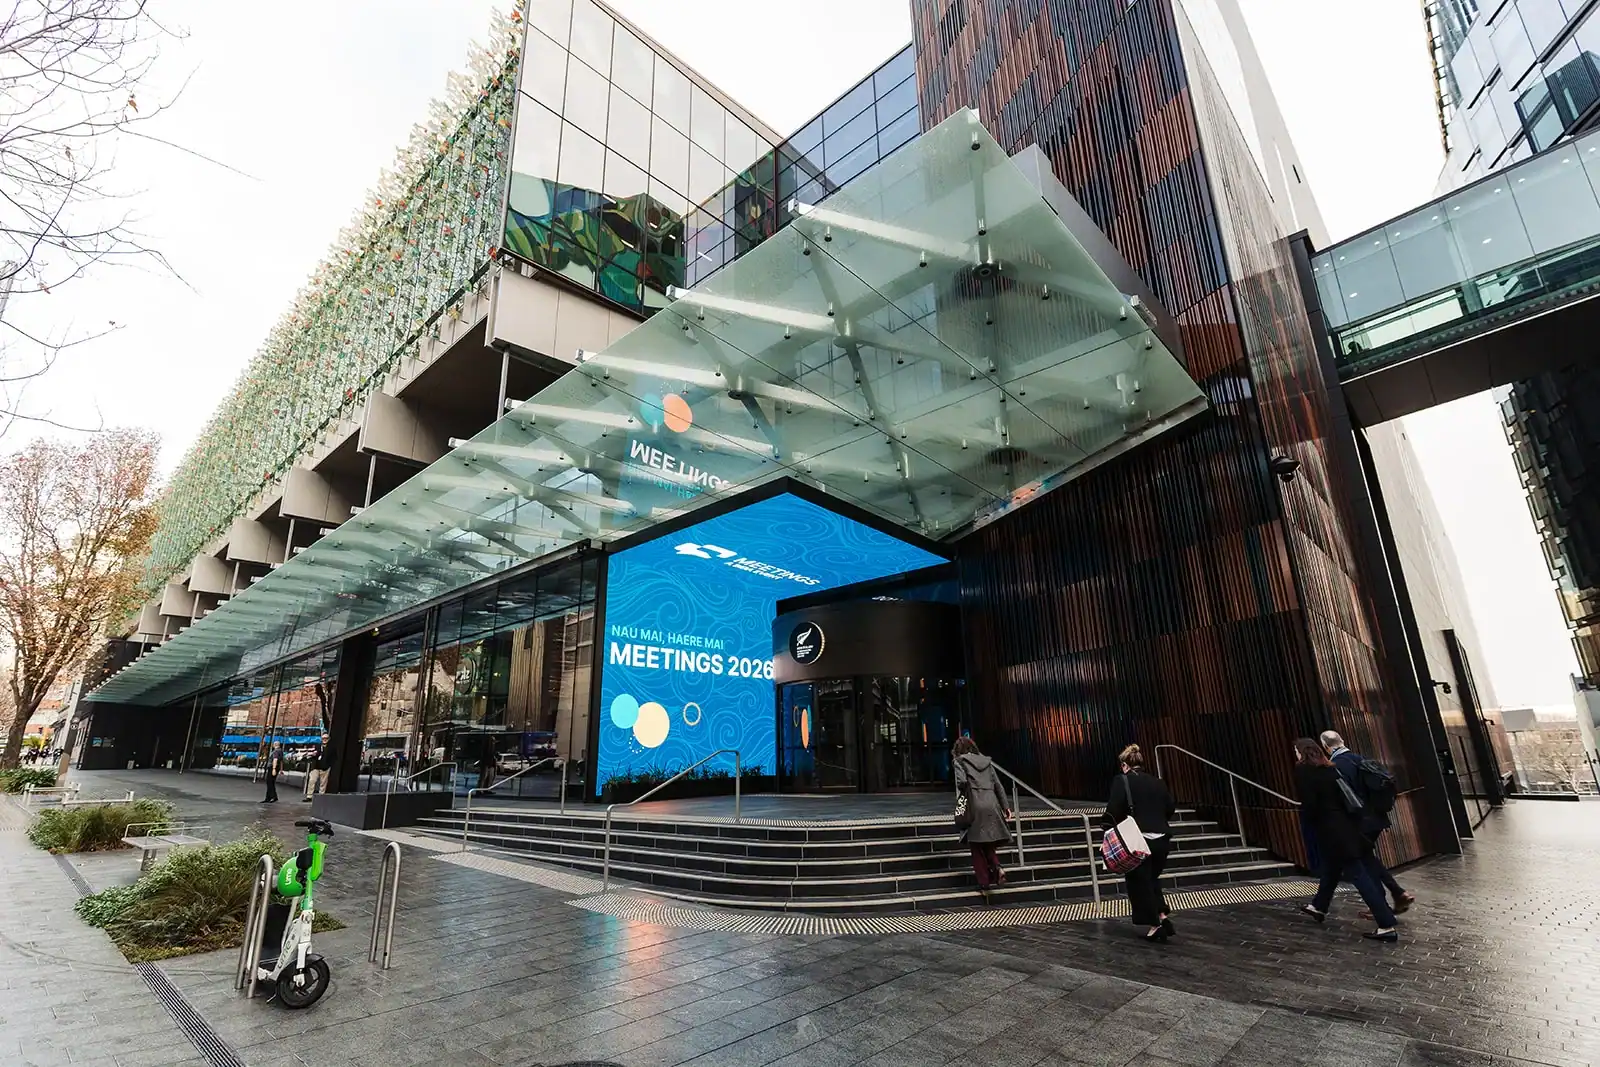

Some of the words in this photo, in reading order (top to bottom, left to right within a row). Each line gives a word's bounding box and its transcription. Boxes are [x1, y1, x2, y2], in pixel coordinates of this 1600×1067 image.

[733, 558, 820, 585] MEETINGS
[611, 625, 638, 639] NAU
[640, 628, 665, 645] MAI,
[668, 632, 703, 647] HAERE
[705, 637, 724, 650] MAI
[610, 642, 724, 675] MEETINGS
[728, 656, 774, 680] 2026
